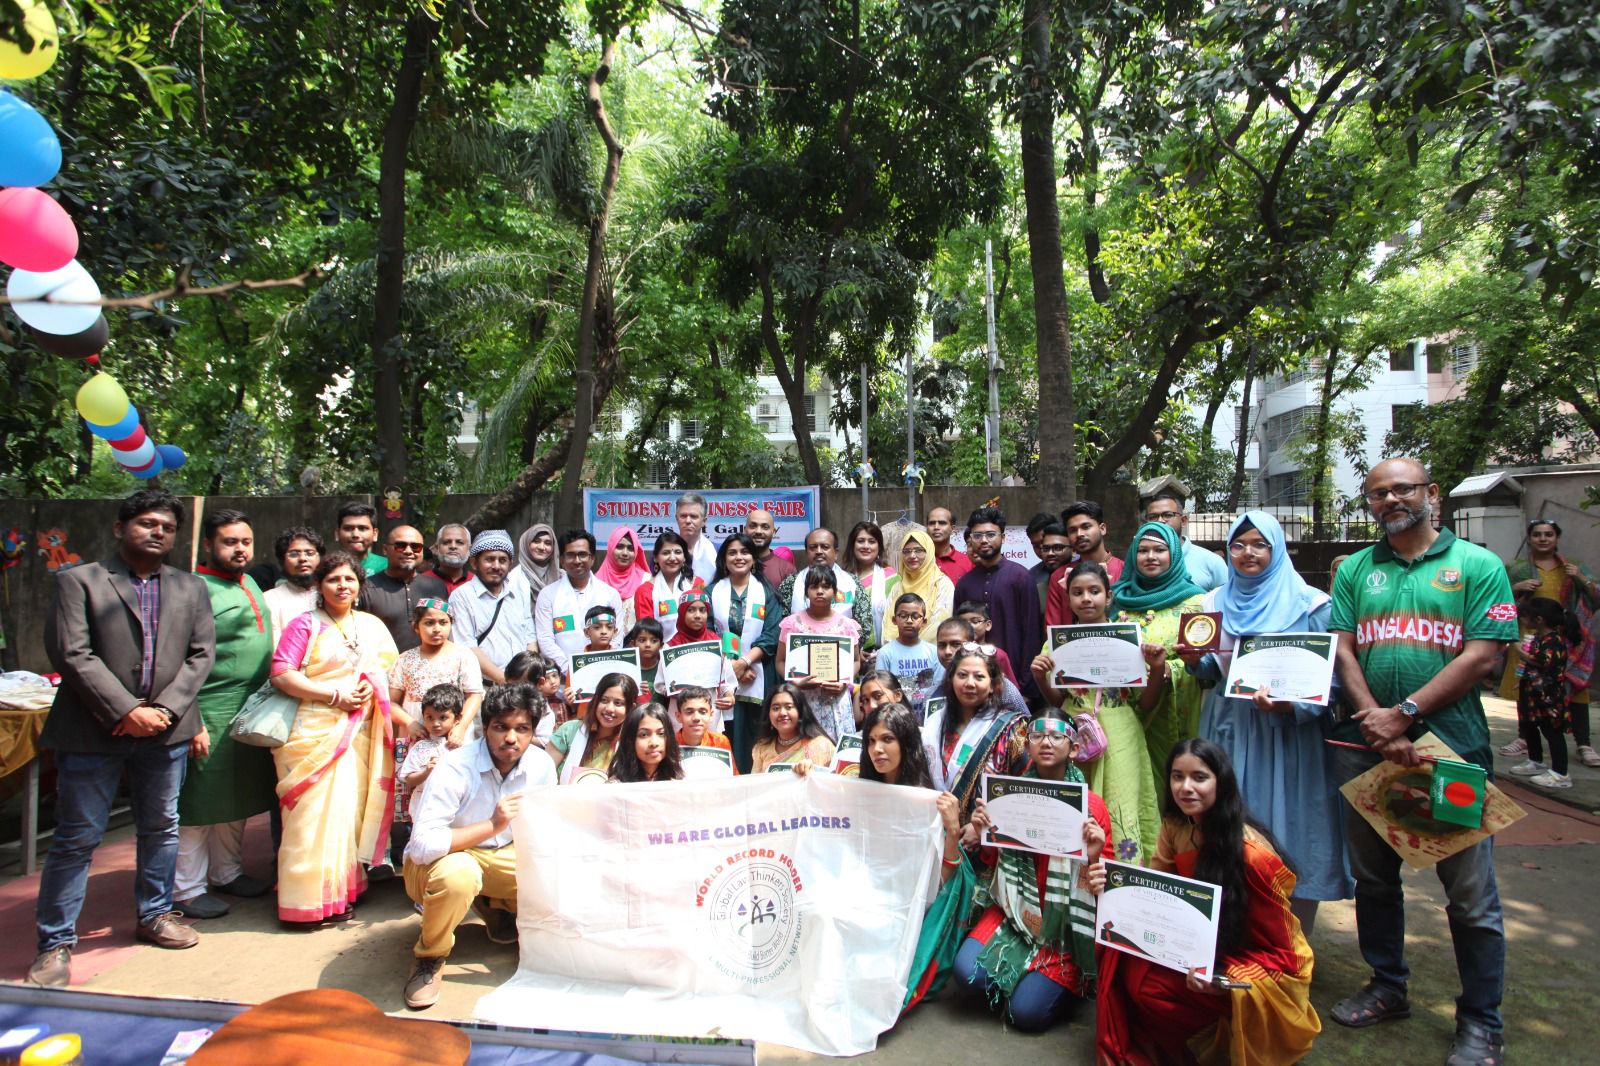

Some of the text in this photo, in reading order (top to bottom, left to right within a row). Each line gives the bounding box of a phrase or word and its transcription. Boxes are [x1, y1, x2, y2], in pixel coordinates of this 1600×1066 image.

[596, 500, 806, 518] STUDENT INESS FAIR
[637, 524, 674, 534] Zias
[1071, 630, 1117, 638] CERTIFICATE
[1260, 640, 1307, 648] CERTIFICATE
[677, 646, 709, 656] CERTIFICATE
[587, 655, 622, 663] CERTIFICATE
[898, 658, 929, 670] SHARK
[1008, 784, 1059, 797] CERTIFICATE
[648, 816, 851, 845] WE ARE GLOBAL LEADERS
[696, 848, 803, 907] WORLD RECORD HOLDER
[750, 870, 785, 891] Thinkers
[1129, 875, 1185, 896] CERTIFICATE
